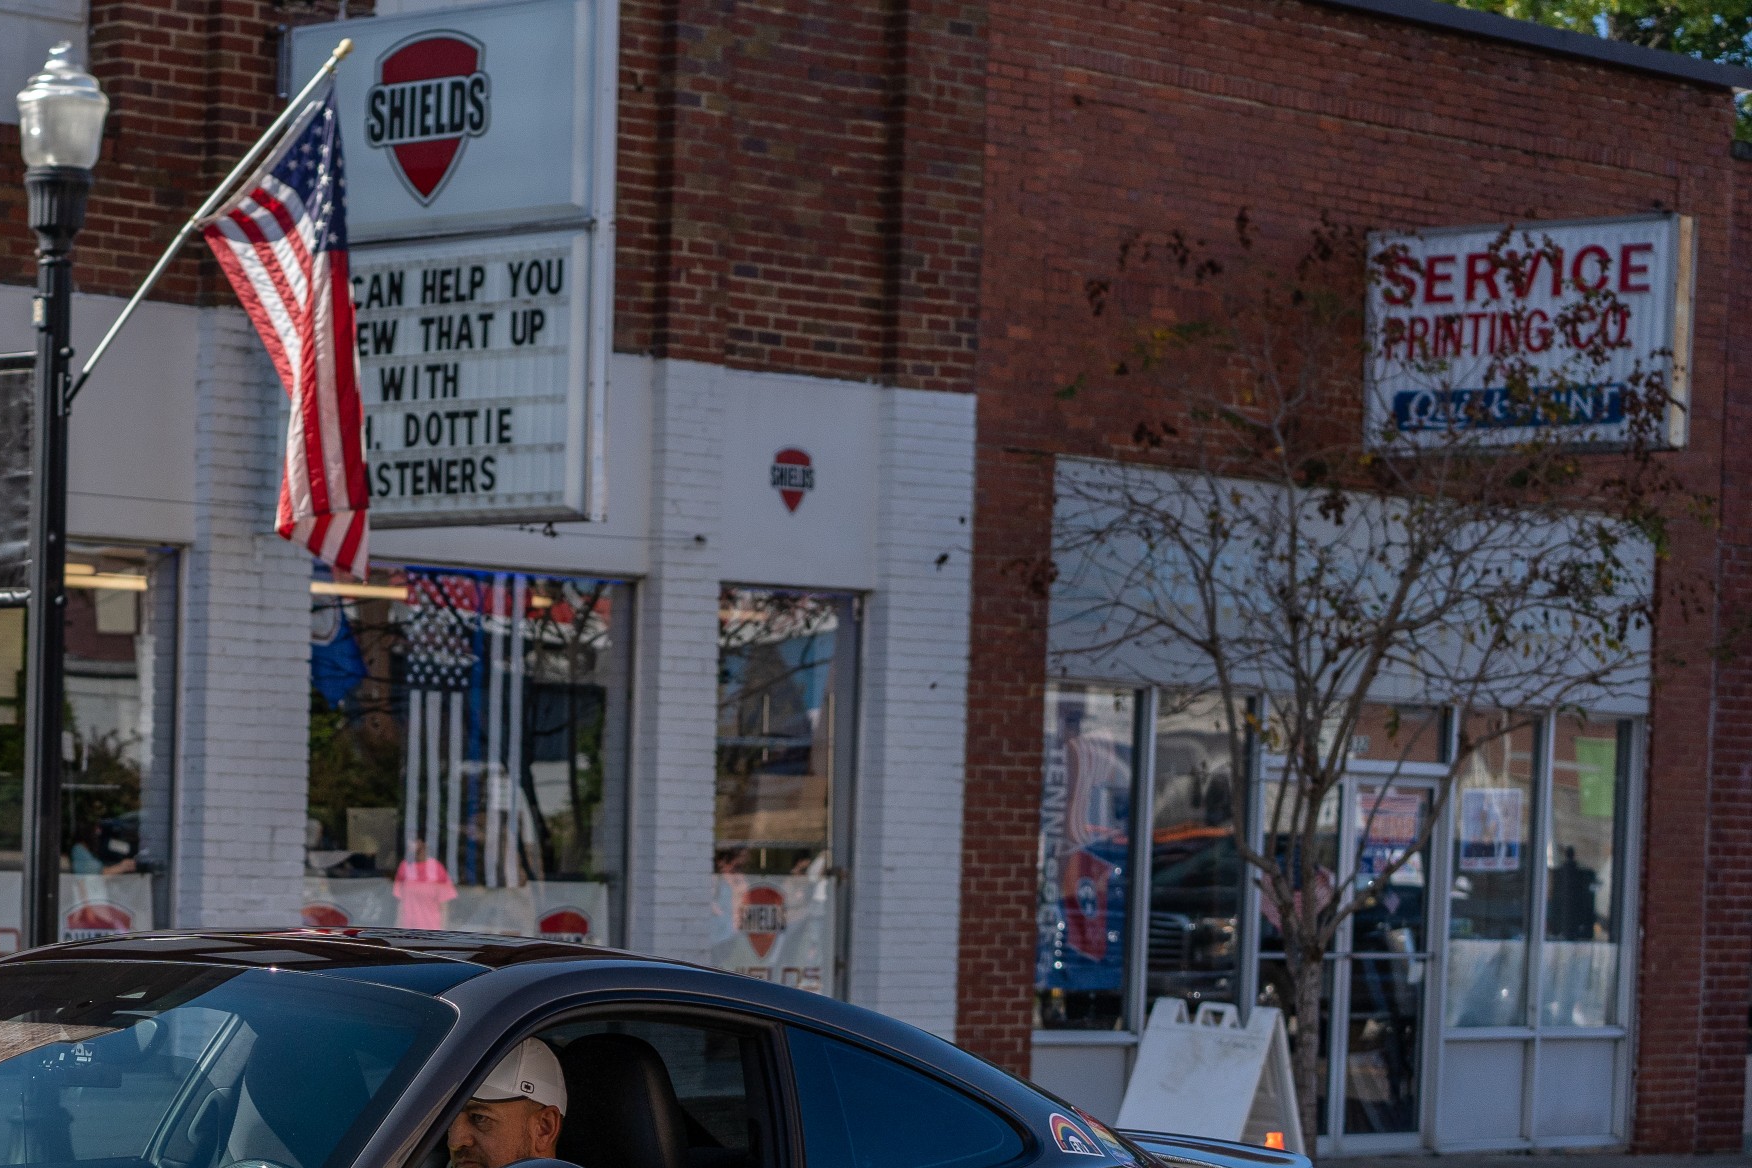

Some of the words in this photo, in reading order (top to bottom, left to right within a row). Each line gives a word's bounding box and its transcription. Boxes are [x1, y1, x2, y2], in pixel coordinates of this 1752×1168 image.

[369, 77, 486, 143] SHIELDS
[352, 270, 404, 310] CAN
[421, 265, 485, 304] HELP
[508, 258, 564, 298] YOU
[1381, 242, 1654, 306] SERVICE
[420, 312, 495, 352] THAT
[510, 308, 545, 346] UP
[1382, 308, 1552, 361] PRINTING
[379, 362, 459, 401] WITH
[404, 407, 512, 448] DOTTIE
